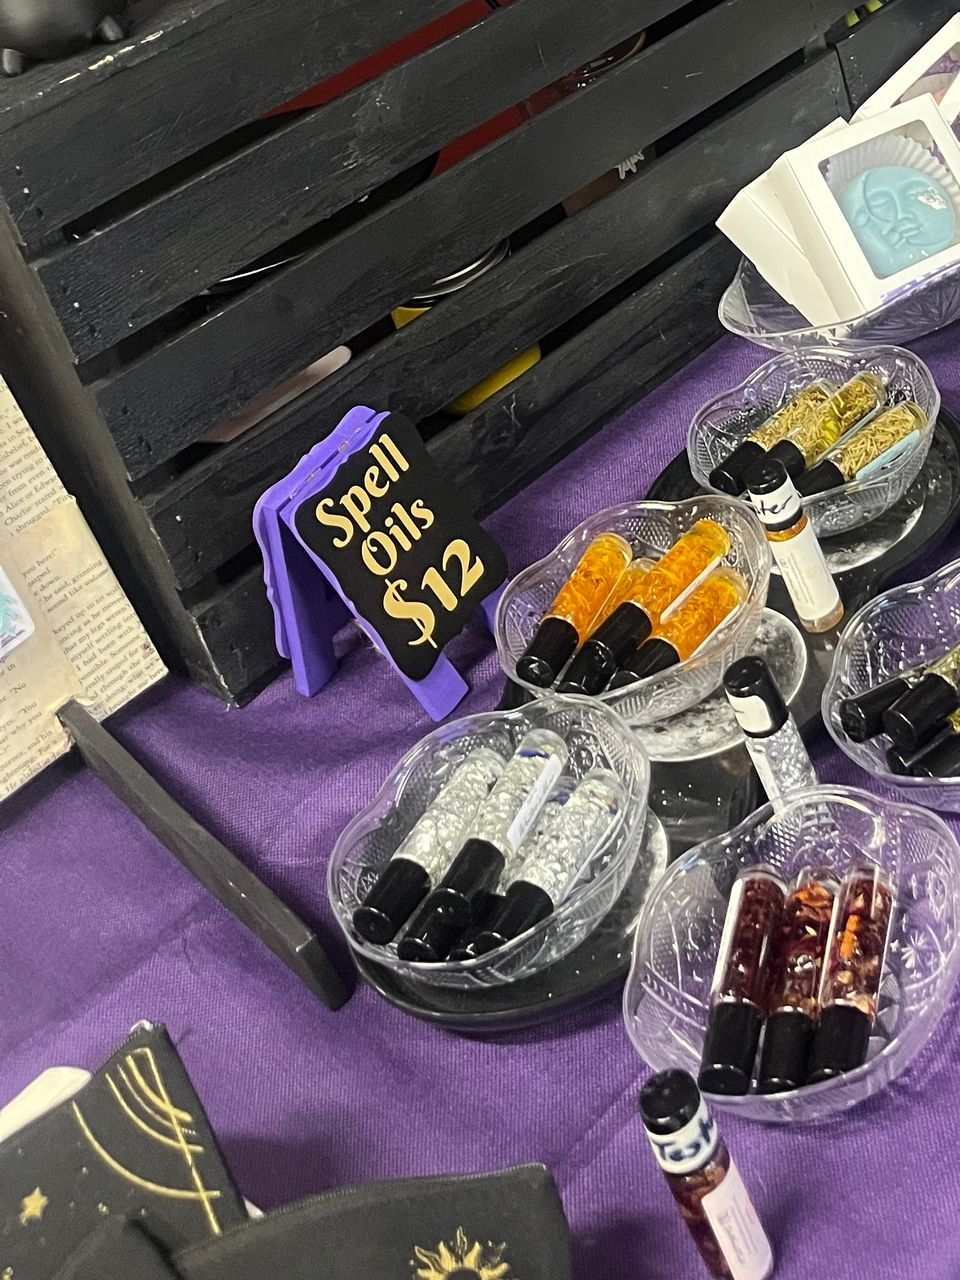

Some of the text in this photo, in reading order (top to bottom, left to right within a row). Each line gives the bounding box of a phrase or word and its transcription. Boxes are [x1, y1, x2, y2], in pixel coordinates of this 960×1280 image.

[4, 505, 32, 526] Charlie
[315, 433, 410, 548] Spell
[361, 499, 435, 576] Oils
[383, 539, 485, 649] $12
